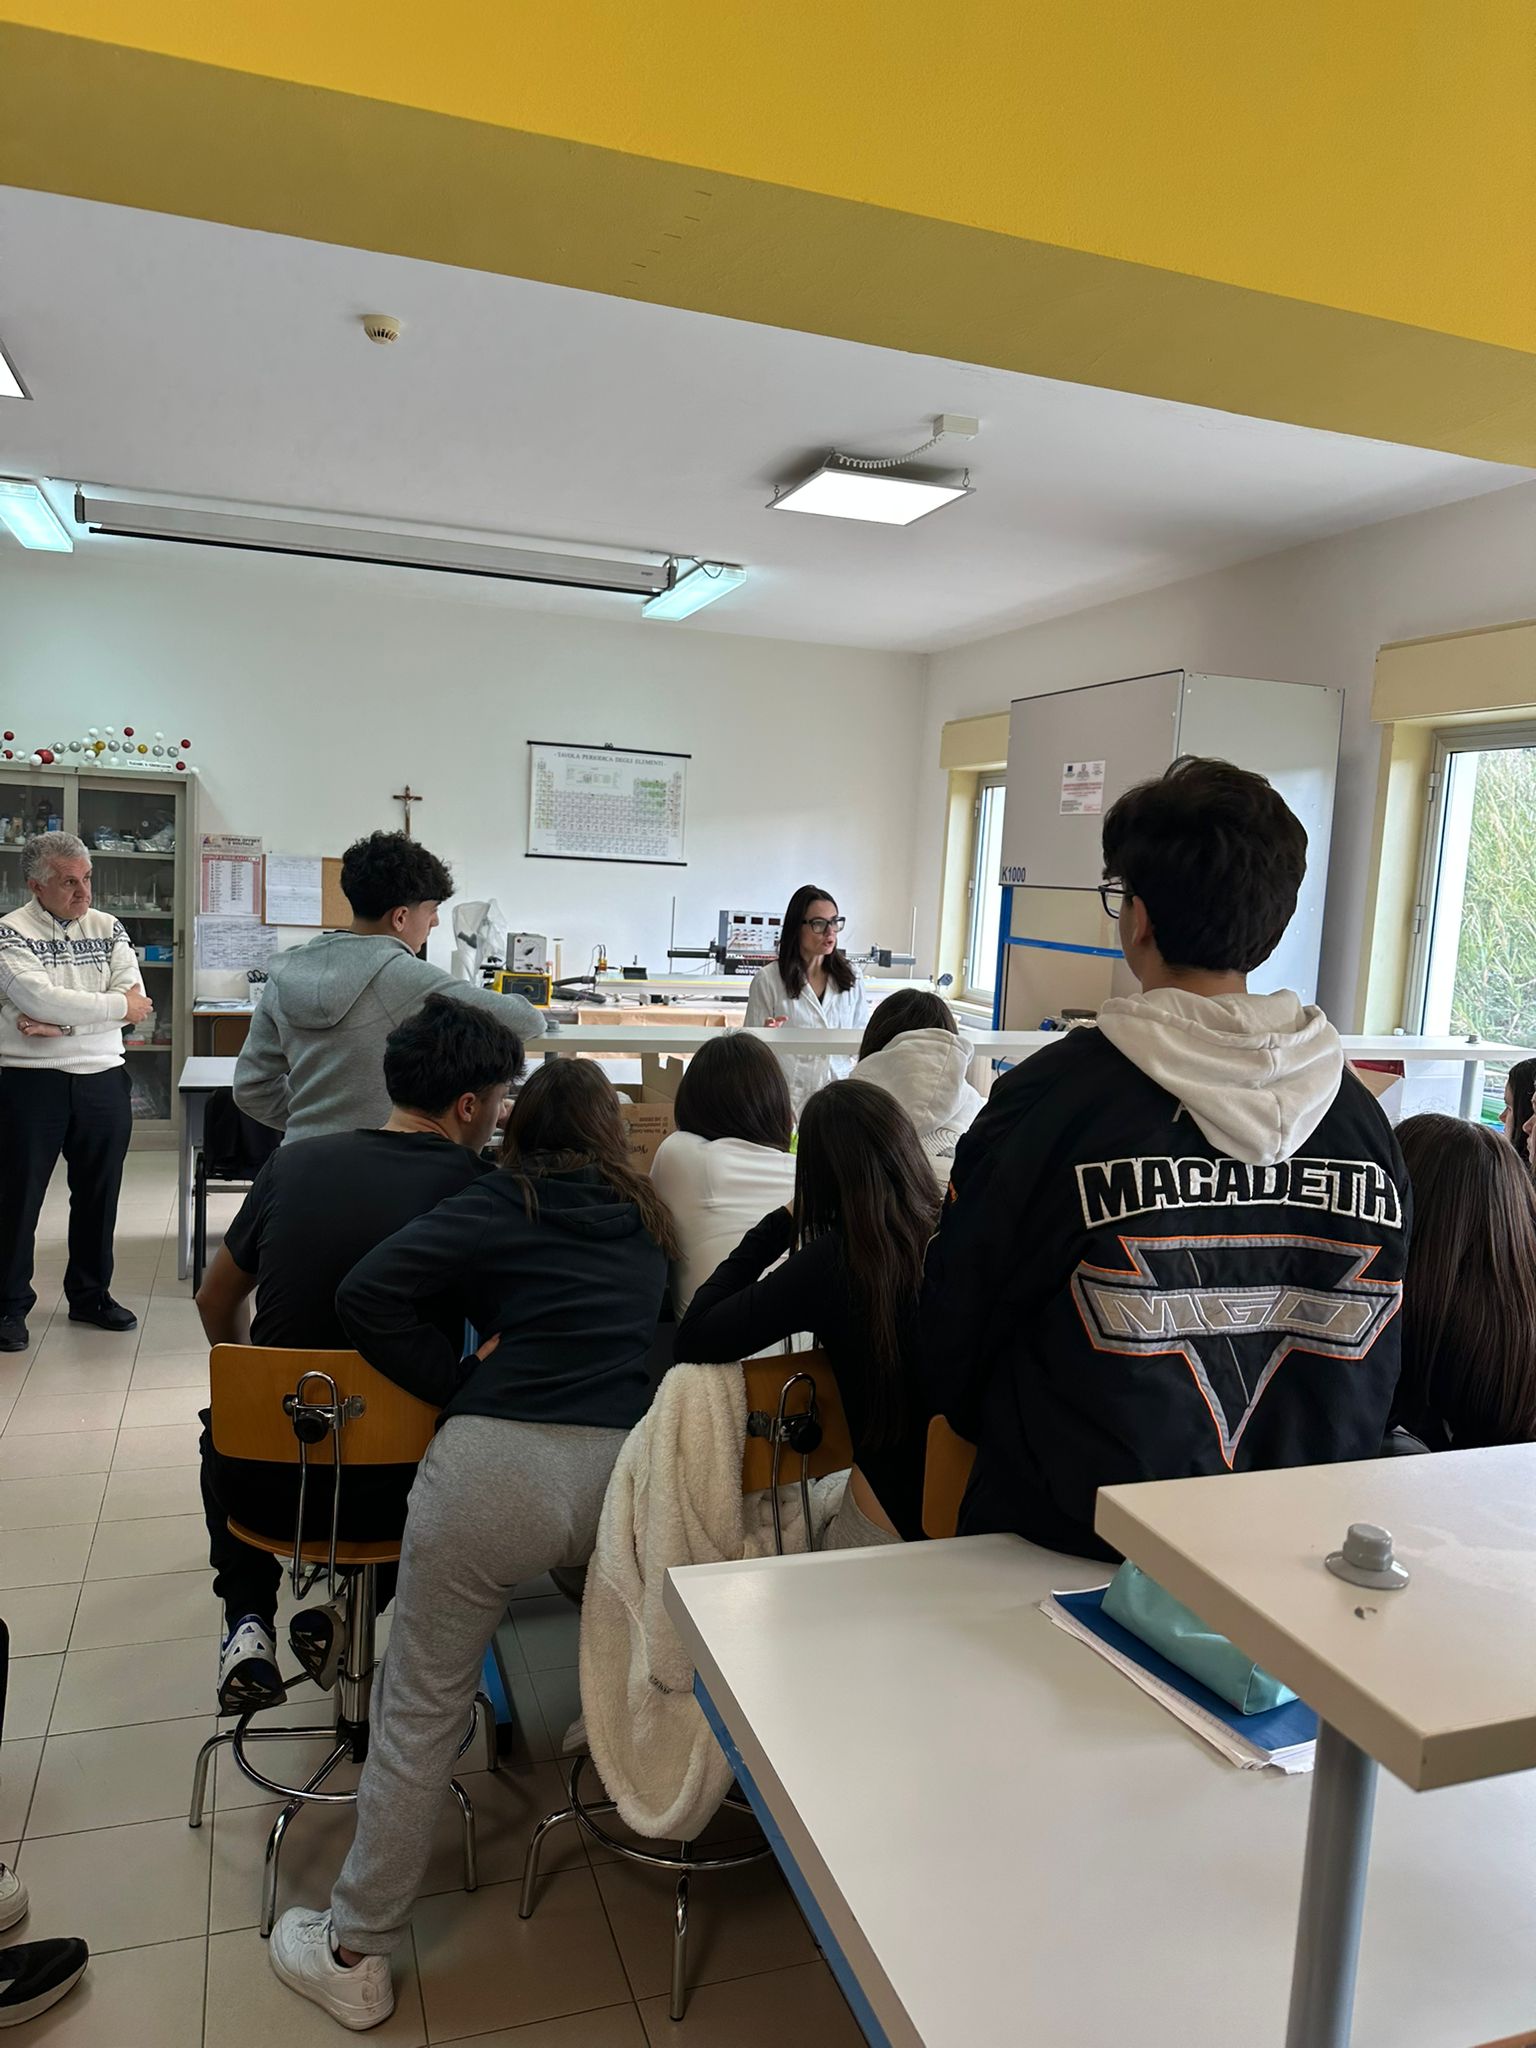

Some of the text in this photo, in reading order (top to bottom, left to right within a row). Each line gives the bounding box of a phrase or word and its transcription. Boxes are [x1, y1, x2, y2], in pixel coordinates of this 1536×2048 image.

[558, 751, 581, 760] TAVOLA
[582, 754, 614, 763] PERIODICA
[1002, 866, 1026, 882] K1000
